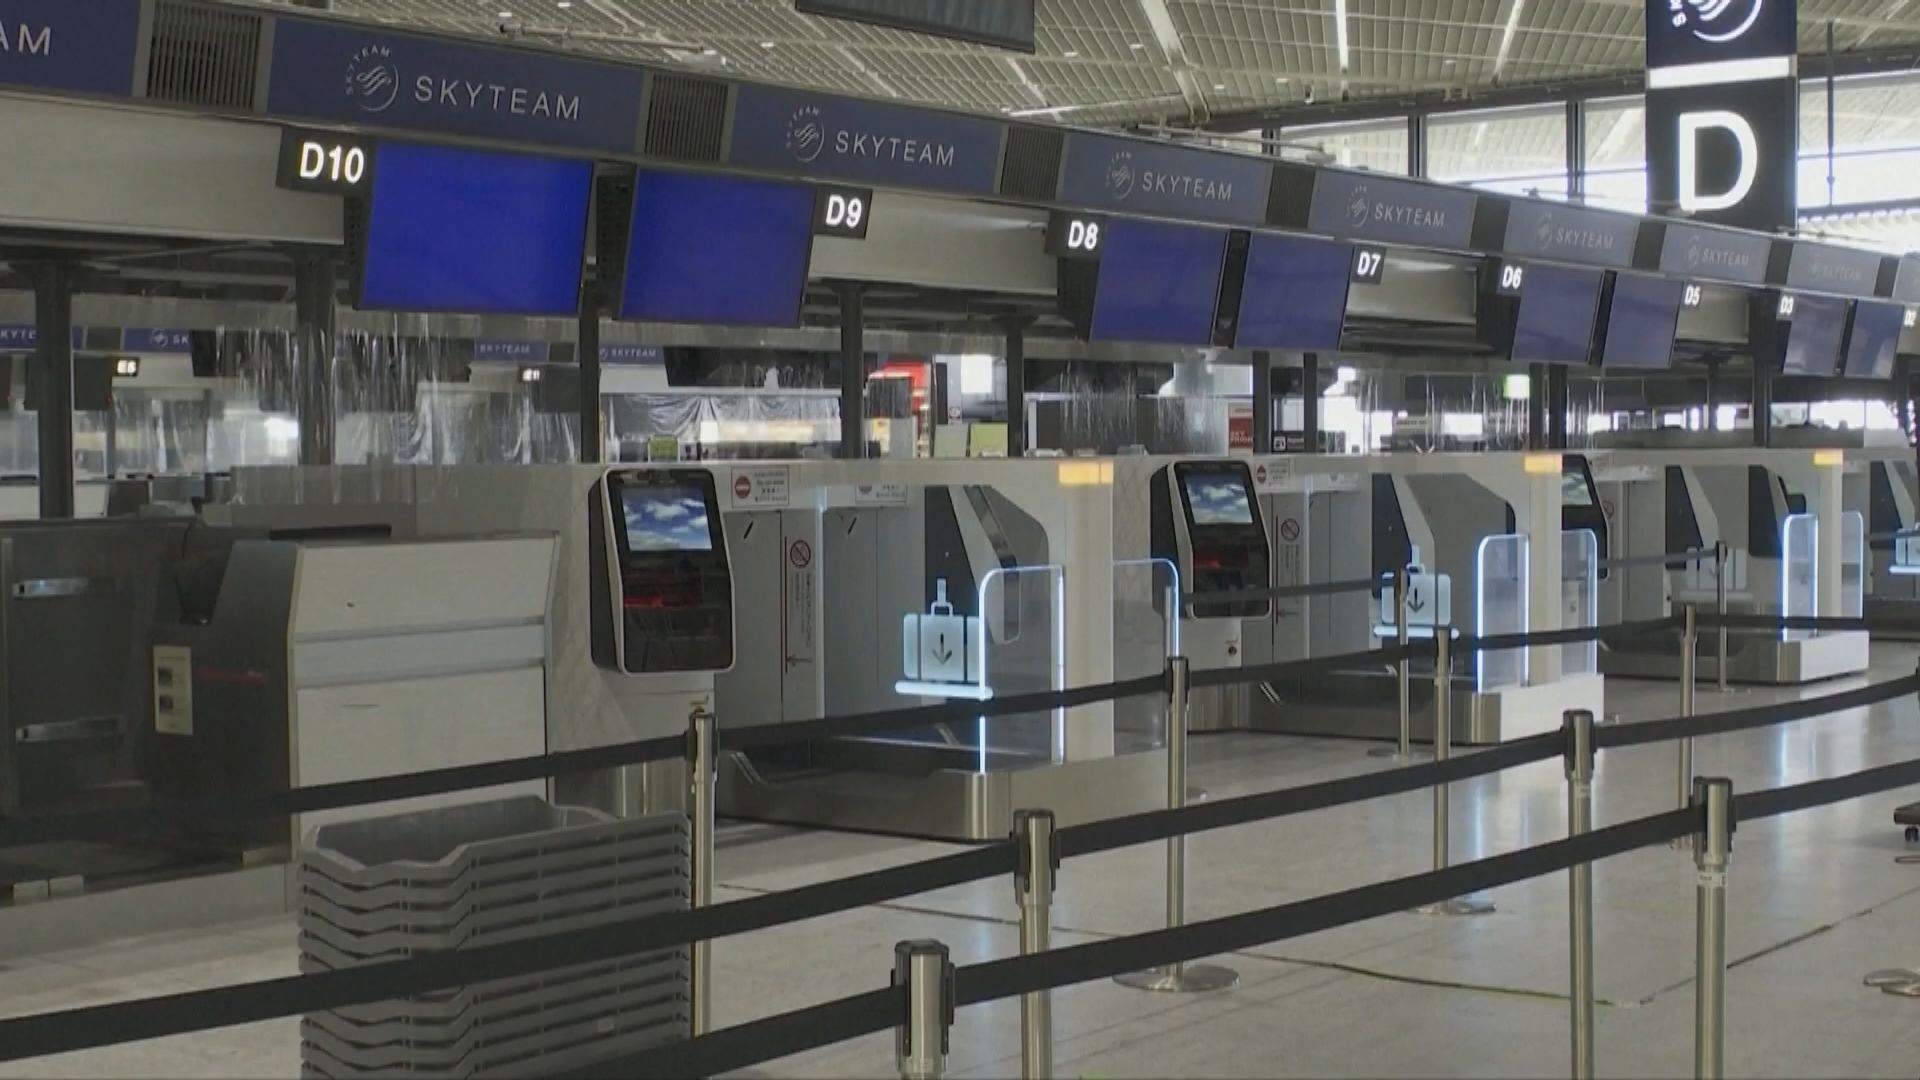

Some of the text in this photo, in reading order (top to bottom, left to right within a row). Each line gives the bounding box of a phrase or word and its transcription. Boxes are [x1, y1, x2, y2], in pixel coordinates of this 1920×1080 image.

[414, 75, 581, 121] SKYTEAM
[835, 129, 955, 167] SKYTEAM
[1679, 110, 1758, 212] D
[299, 141, 365, 184] D10
[1142, 170, 1233, 201] SKYTEAM
[825, 194, 863, 228] D9
[1373, 203, 1448, 228] SKYTEAM
[1067, 219, 1099, 251] D8
[1555, 225, 1616, 249] SKYTEAM
[1357, 251, 1382, 277] D7
[1701, 246, 1751, 267] SKYTEAM
[1501, 265, 1523, 290] D6
[1683, 285, 1700, 306] D5
[1779, 295, 1795, 316] D3
[1903, 310, 1918, 328] D2
